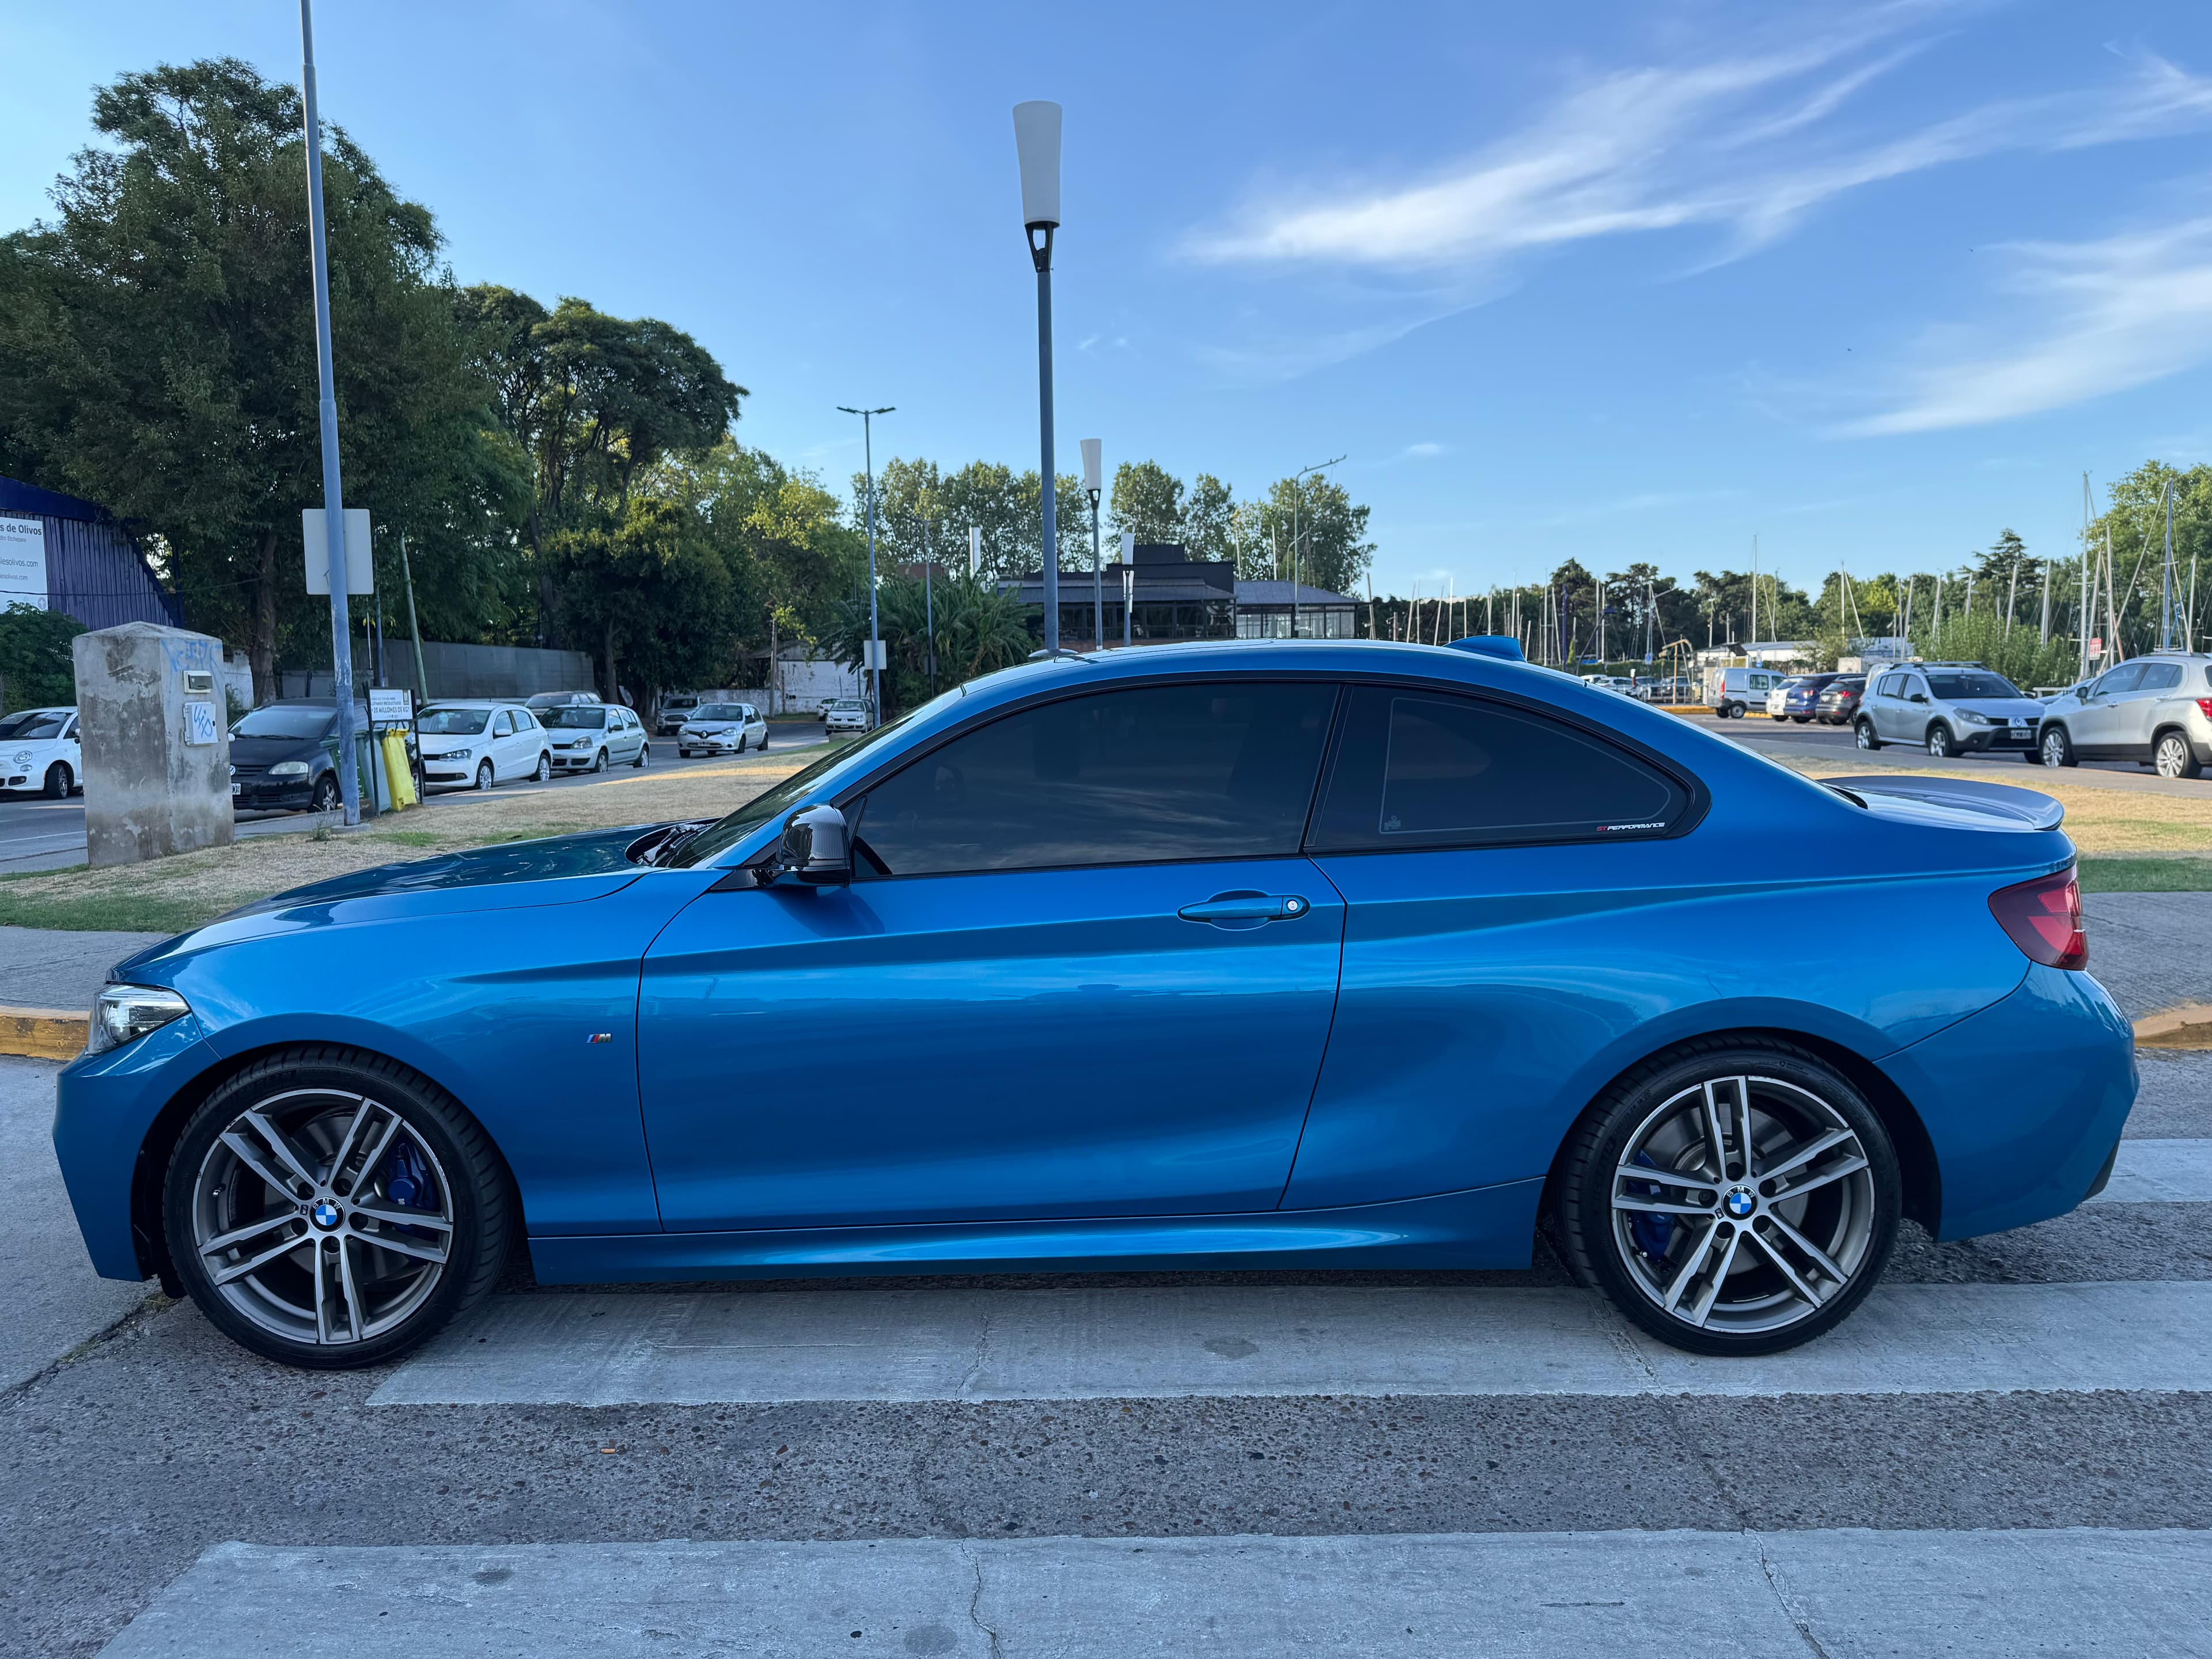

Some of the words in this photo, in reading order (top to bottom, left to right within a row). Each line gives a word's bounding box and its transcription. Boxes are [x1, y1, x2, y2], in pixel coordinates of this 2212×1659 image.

[6, 523, 17, 533] de
[18, 525, 42, 536] Olivos
[1726, 1187, 1755, 1198] BMW
[312, 1198, 342, 1210] BMW
